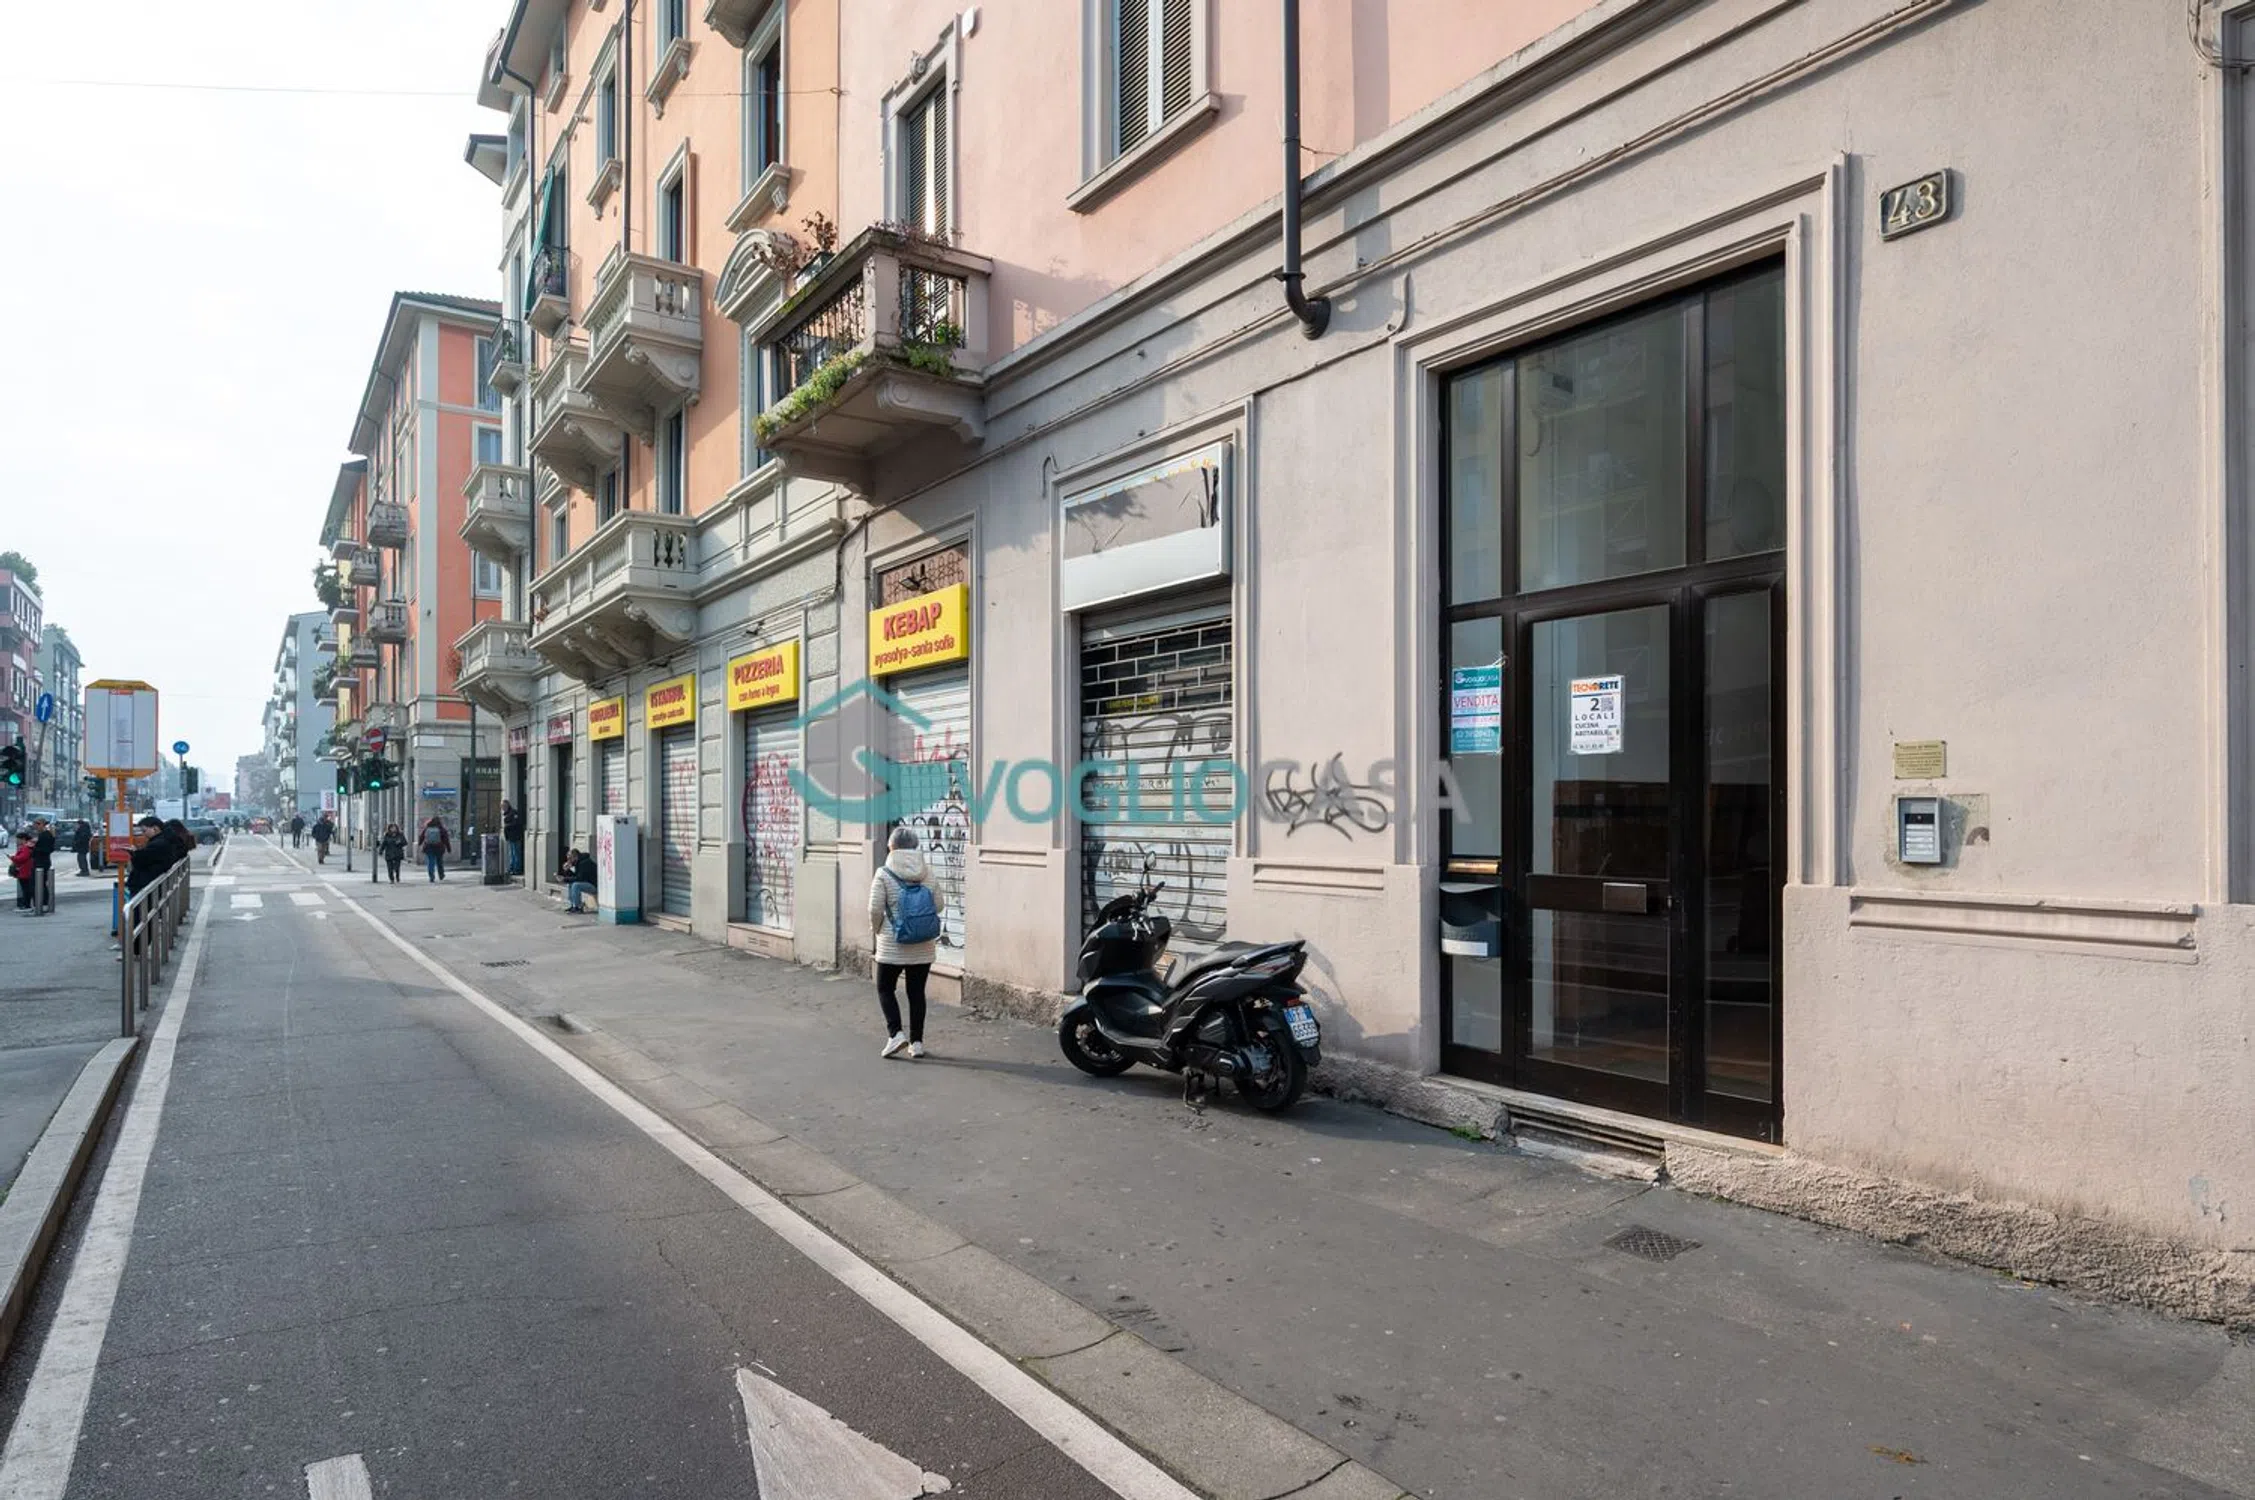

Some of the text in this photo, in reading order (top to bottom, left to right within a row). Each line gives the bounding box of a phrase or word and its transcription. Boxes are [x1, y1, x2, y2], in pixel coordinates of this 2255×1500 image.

[1888, 181, 1937, 225] 43
[883, 602, 941, 641] KEBAP
[734, 654, 784, 685] PIZZERIA
[1573, 681, 1619, 692] TECNORETE
[1453, 694, 1499, 708] VENDITA
[1590, 697, 1600, 711] 2
[1575, 712, 1614, 721] LOCALI
